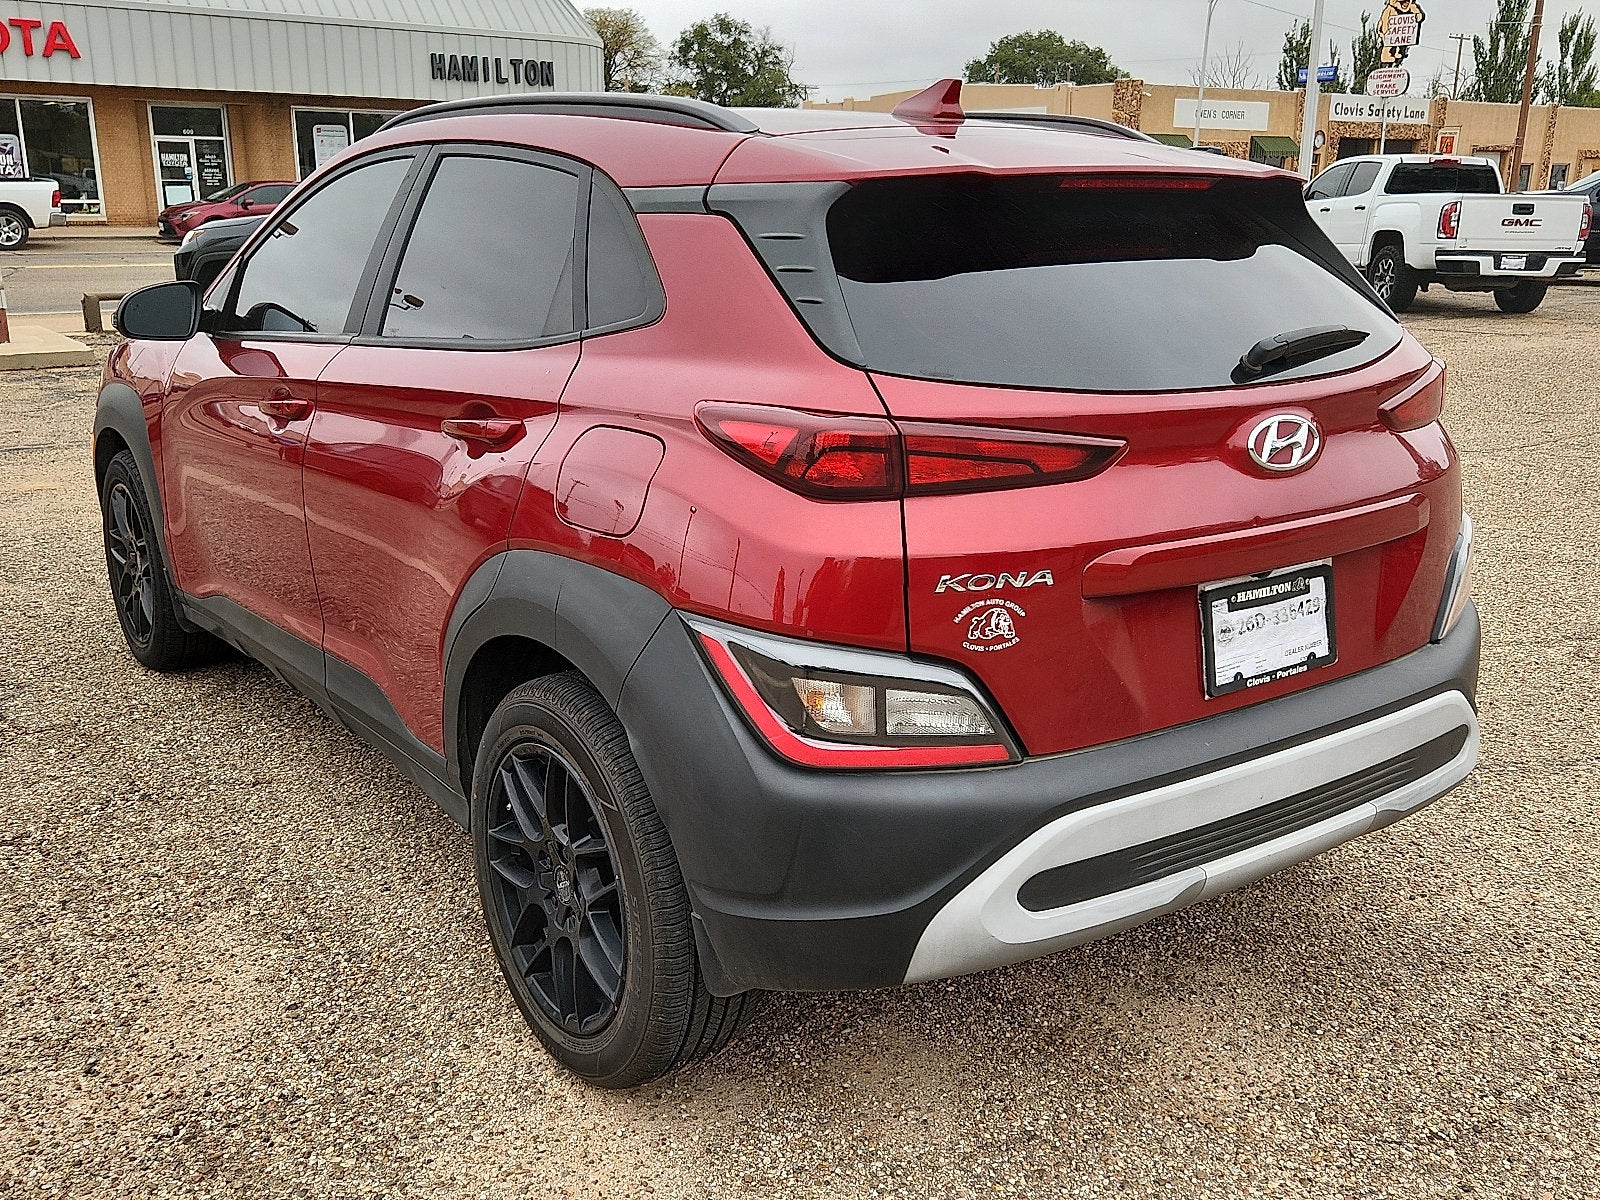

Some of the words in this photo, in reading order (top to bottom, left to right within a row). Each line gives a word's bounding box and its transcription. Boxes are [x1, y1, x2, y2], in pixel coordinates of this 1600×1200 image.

[1389, 16, 1415, 25] CLOVIS
[0, 18, 81, 59] TA
[1387, 25, 1416, 35] SAFETY
[1390, 36, 1412, 44] LANE
[430, 53, 554, 86] HAMILTON
[1221, 110, 1245, 120] CORNER
[1334, 102, 1364, 117] Clovis
[1367, 103, 1402, 121] Safety
[1404, 106, 1425, 119] Lane
[160, 153, 188, 161] HAMILTON
[1501, 219, 1542, 227] GMC
[934, 569, 1054, 593] KONA
[1236, 581, 1292, 603] HAMILTON
[953, 600, 985, 623] HAMILTON
[1005, 601, 1026, 617] GROUP
[962, 641, 985, 652] CLOVIS
[988, 636, 1021, 652] PORTALES
[1246, 675, 1270, 687] Clovis
[1276, 664, 1307, 679] Portales
